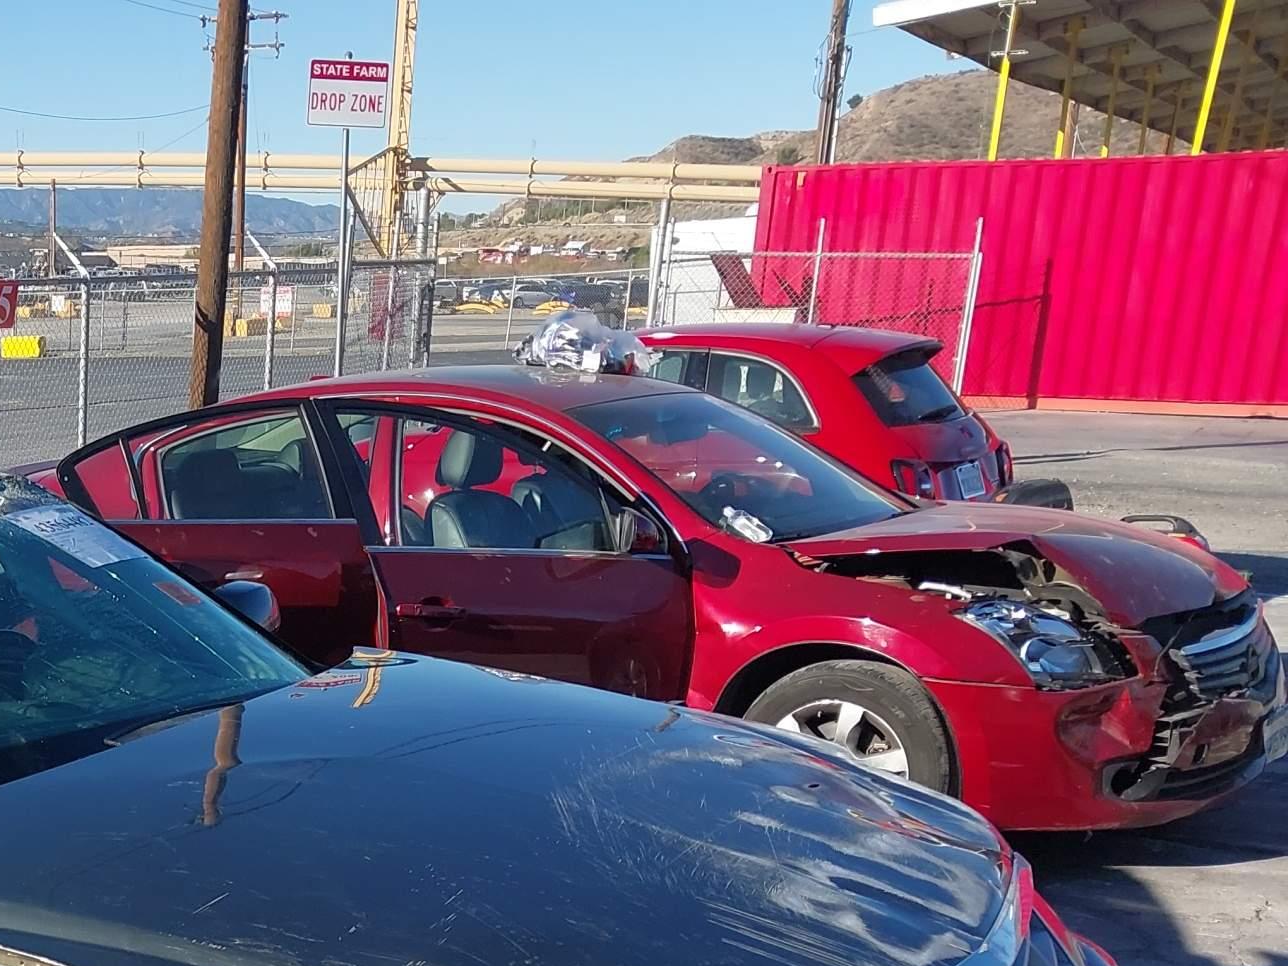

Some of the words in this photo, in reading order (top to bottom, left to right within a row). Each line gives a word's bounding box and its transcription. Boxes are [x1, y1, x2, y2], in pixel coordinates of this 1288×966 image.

[312, 63, 350, 77] STATE
[353, 65, 387, 78] FARM
[311, 91, 346, 111] DROP
[350, 94, 384, 113] ZONE
